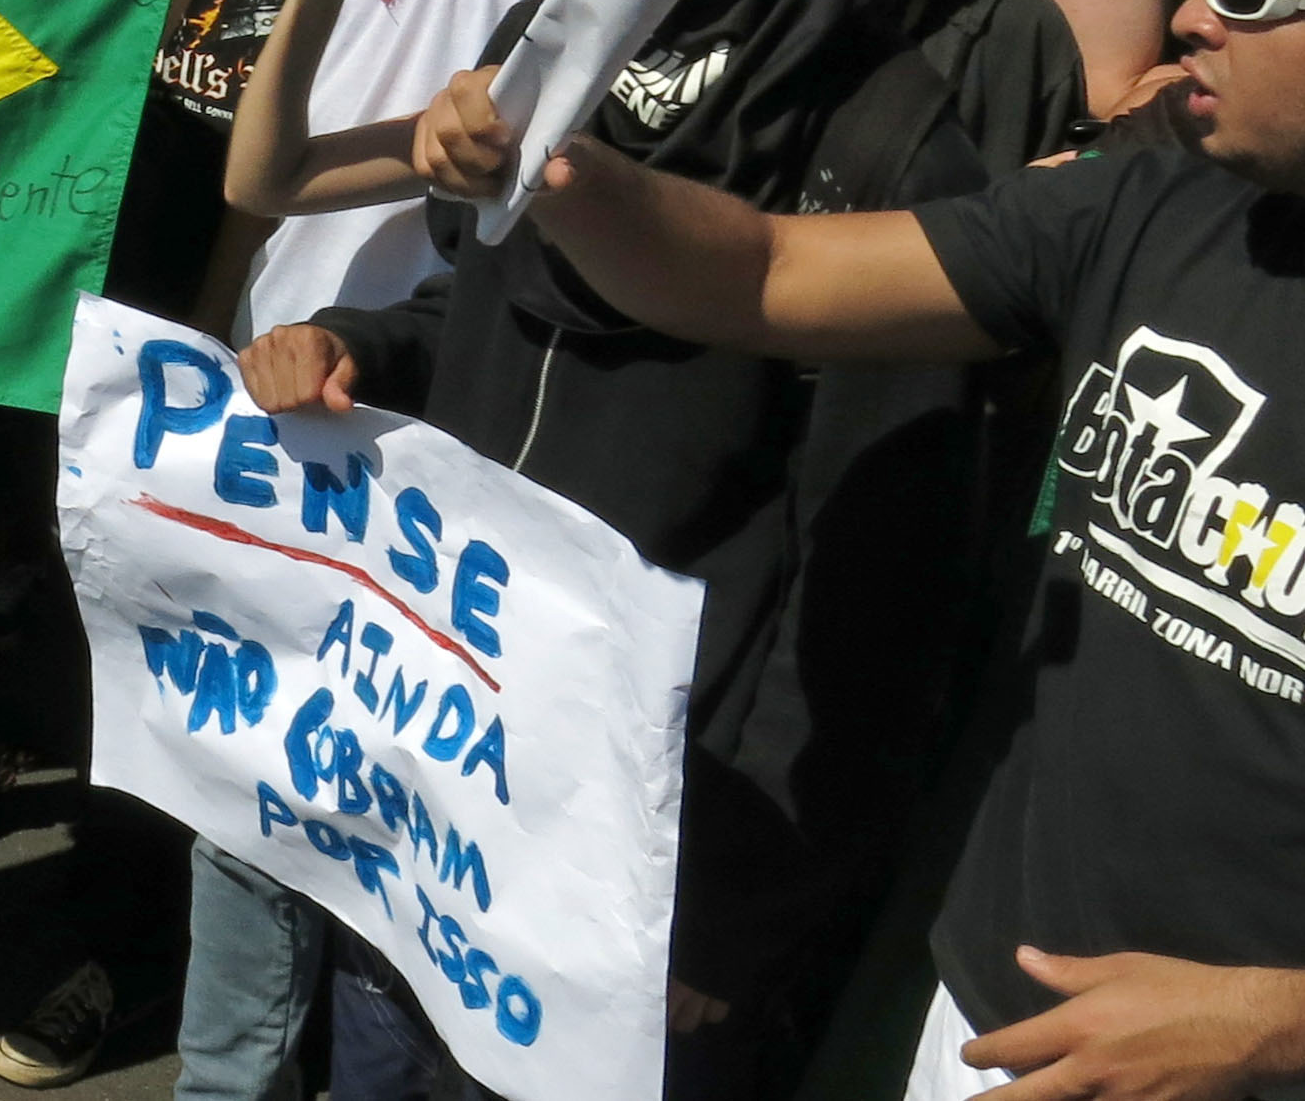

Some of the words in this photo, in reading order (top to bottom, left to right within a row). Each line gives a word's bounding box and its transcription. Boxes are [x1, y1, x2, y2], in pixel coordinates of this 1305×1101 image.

[132, 338, 512, 659] PENSE
[1079, 548, 1149, 624] ARRIL
[1151, 607, 1235, 671] ZONA
[137, 609, 279, 736] NÃO
[282, 685, 493, 913] COBRAM
[316, 598, 511, 806] AINDA
[257, 779, 402, 921] POR
[415, 885, 544, 1048] ISSO
